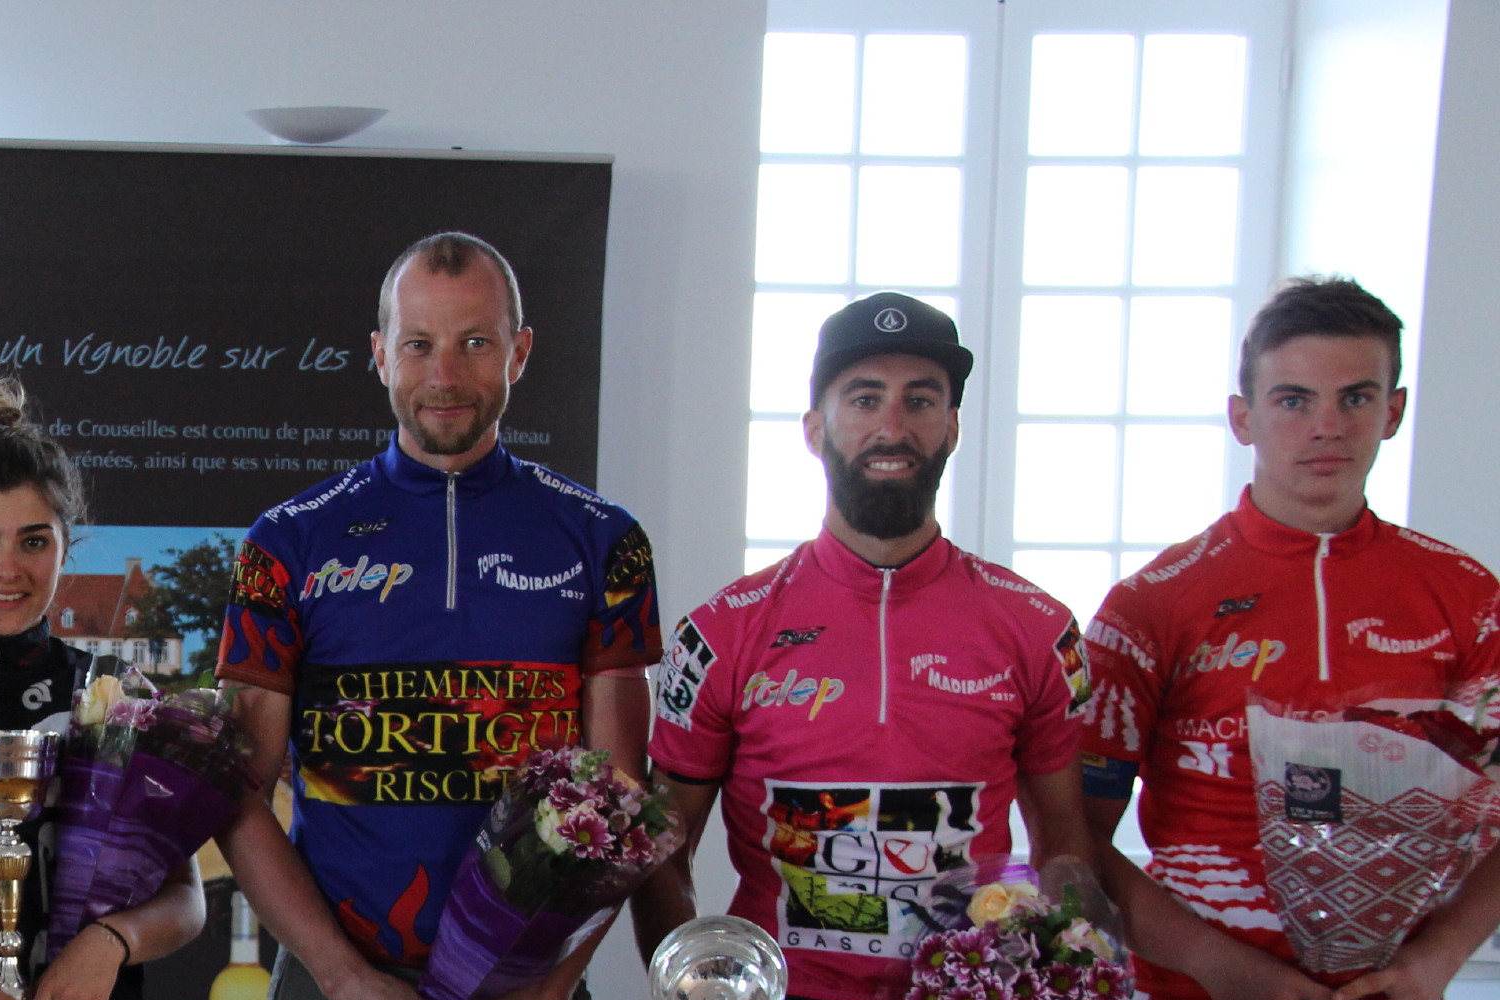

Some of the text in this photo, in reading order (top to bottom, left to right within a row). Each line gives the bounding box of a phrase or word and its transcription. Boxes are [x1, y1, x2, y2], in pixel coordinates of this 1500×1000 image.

[220, 345, 286, 370] sur
[49, 418, 72, 437] de
[77, 418, 177, 439] Crouseilles
[182, 422, 207, 438] est
[213, 424, 270, 440] connu
[276, 420, 297, 440] de
[304, 425, 333, 446] par
[338, 427, 370, 441] son
[500, 426, 551, 444] âteau
[145, 452, 190, 470] ainsi
[193, 456, 227, 474] que
[232, 456, 258, 471] ses
[264, 452, 299, 471] vins
[305, 456, 328, 472] ne
[284, 467, 358, 517] MADIRANAIS
[348, 476, 371, 494] 2017
[583, 502, 608, 520] 2017
[477, 553, 514, 579] TOUR DU
[495, 561, 584, 591] MADIRANAIS
[560, 589, 585, 600] 2017
[1028, 596, 1055, 616] 2017
[910, 653, 948, 681] TOUR DU
[990, 692, 1016, 701] 2017
[787, 931, 914, 958] GASCO
